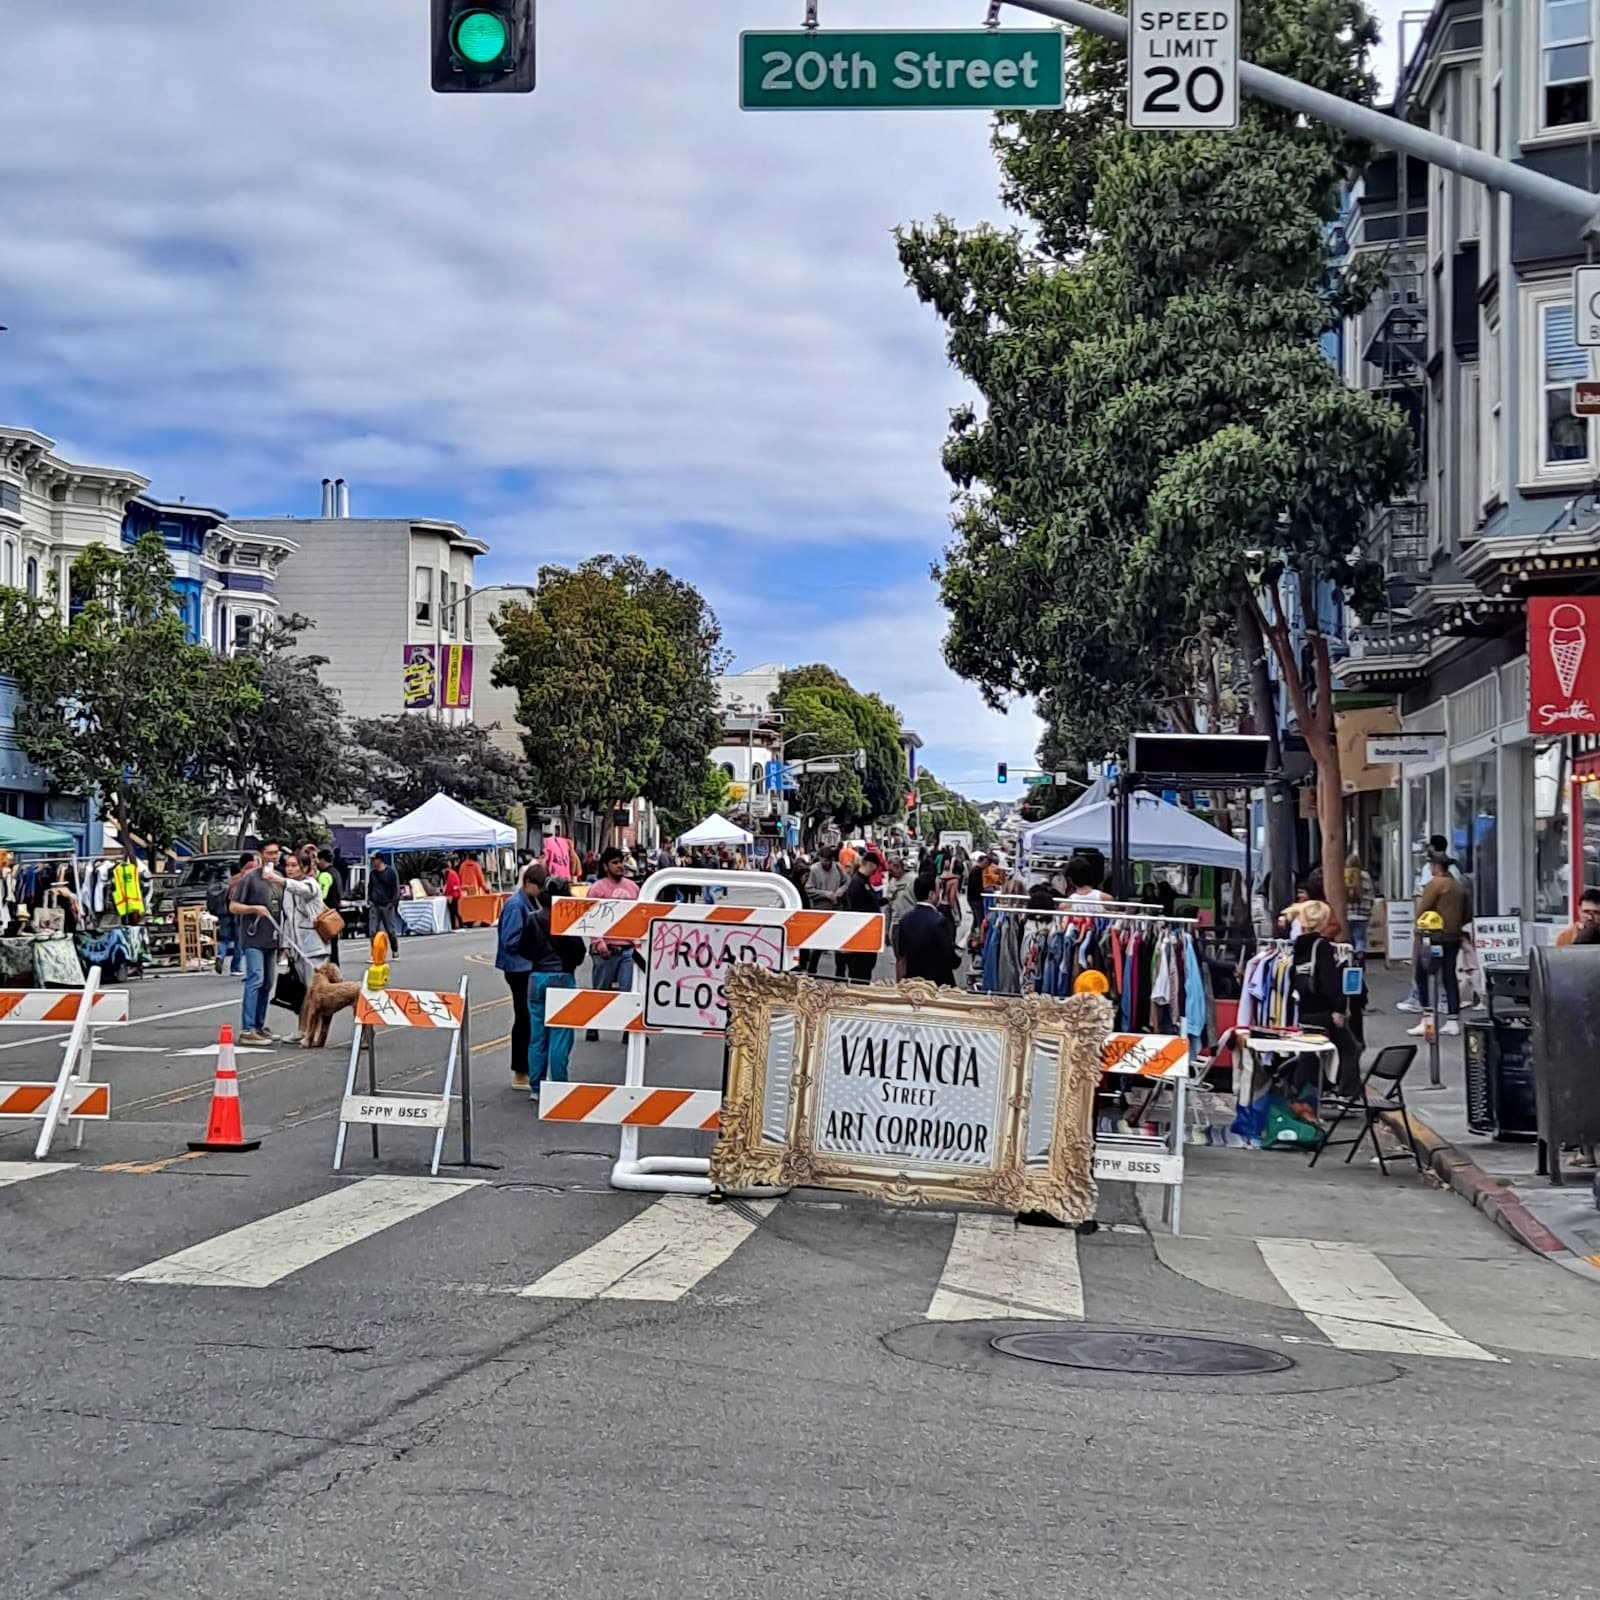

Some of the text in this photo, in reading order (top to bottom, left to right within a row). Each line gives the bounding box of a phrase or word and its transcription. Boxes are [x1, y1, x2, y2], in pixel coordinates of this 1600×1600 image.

[1140, 12, 1228, 31] SPEED
[1149, 39, 1218, 58] LIMIT
[761, 51, 1039, 90] 20th Street
[1143, 66, 1224, 113] 20
[673, 941, 758, 969] ROAD
[841, 1034, 980, 1088] VALENCIA
[881, 1081, 937, 1107] STREET
[360, 1105, 393, 1118] SFPW
[825, 1110, 988, 1153] ART CORRIDOR
[1127, 1161, 1161, 1174] BSES
